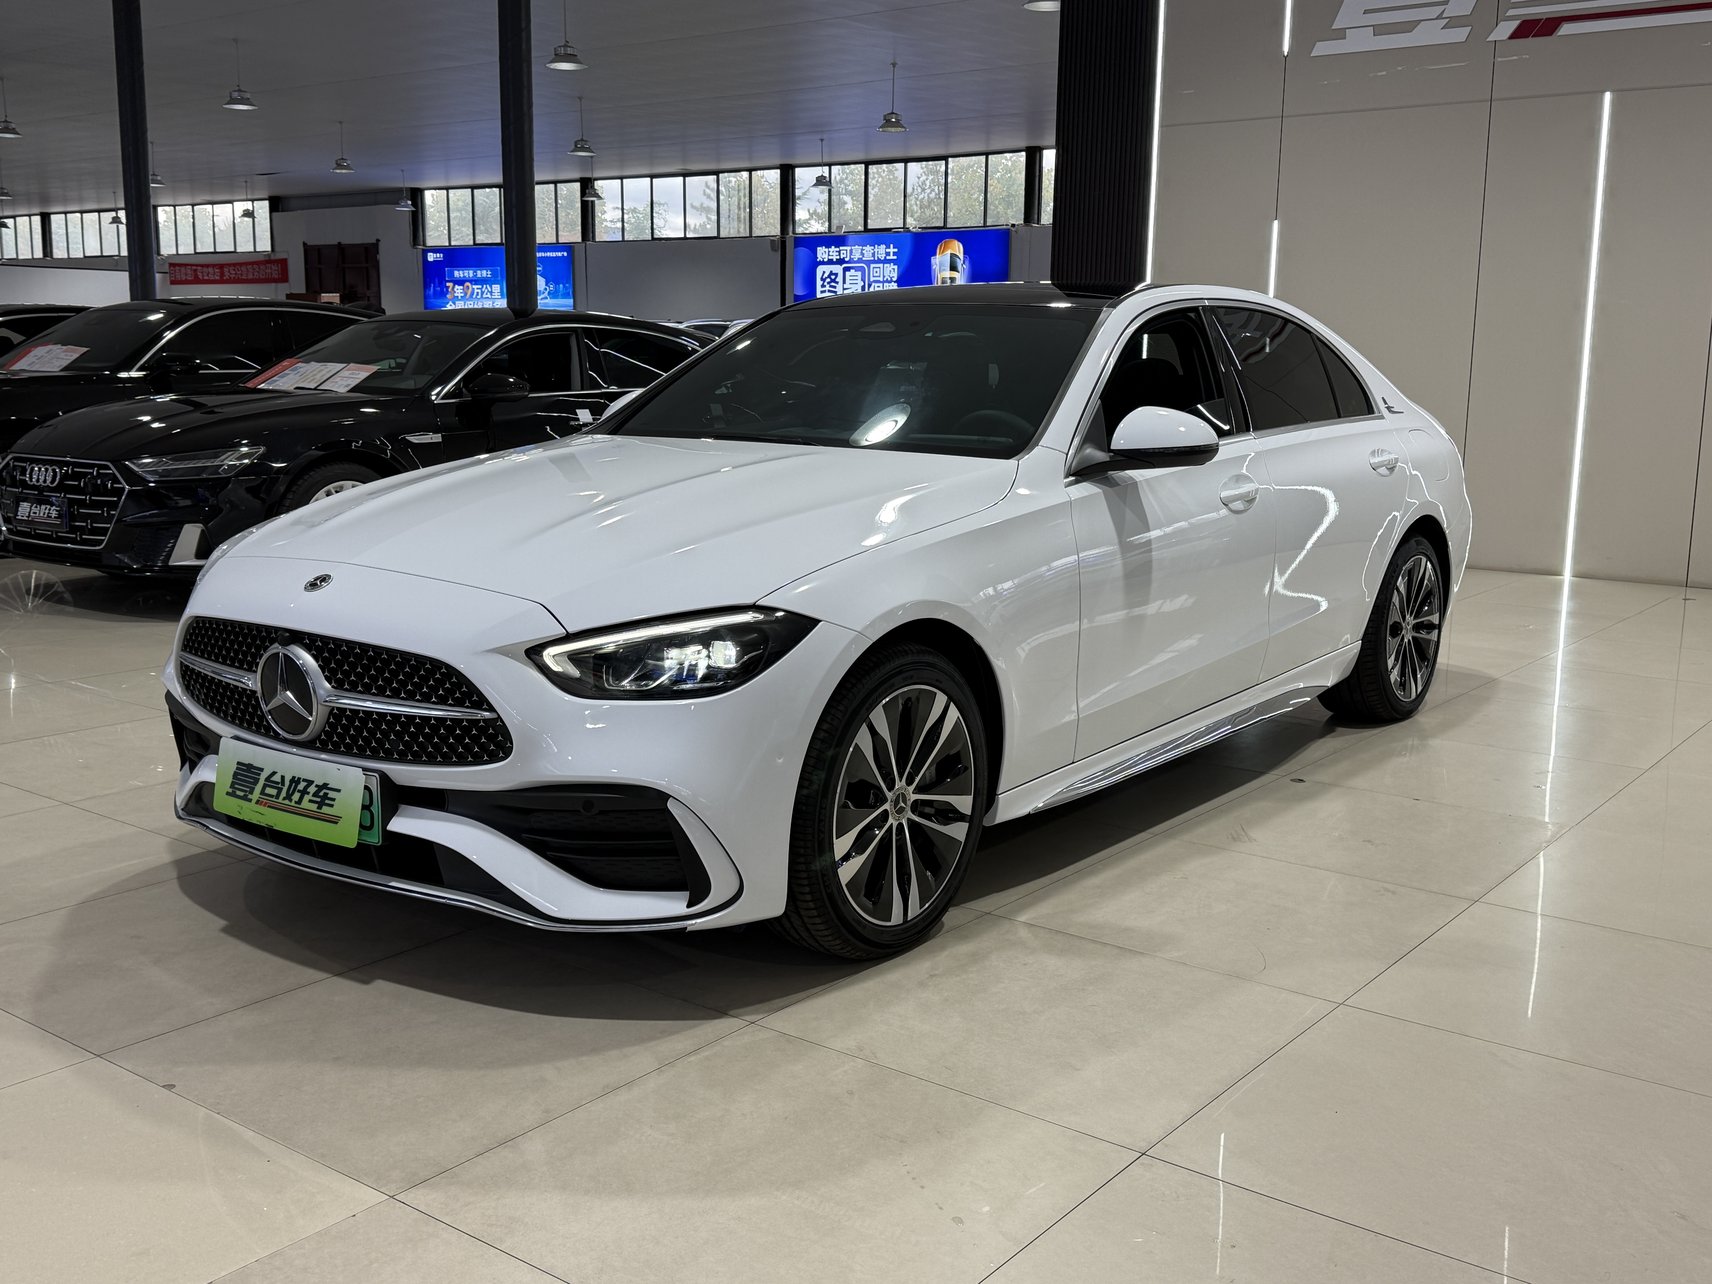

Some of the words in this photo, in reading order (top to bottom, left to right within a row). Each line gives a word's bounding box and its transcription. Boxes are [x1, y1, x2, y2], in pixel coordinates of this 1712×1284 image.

[817, 244, 898, 261] 购车可享查博士
[870, 263, 898, 281] 回购
[446, 282, 501, 299] 3年9万公里
[819, 269, 864, 295] 终身
[16, 502, 60, 519] 壹台好车
[226, 761, 341, 811] 壹台好车
